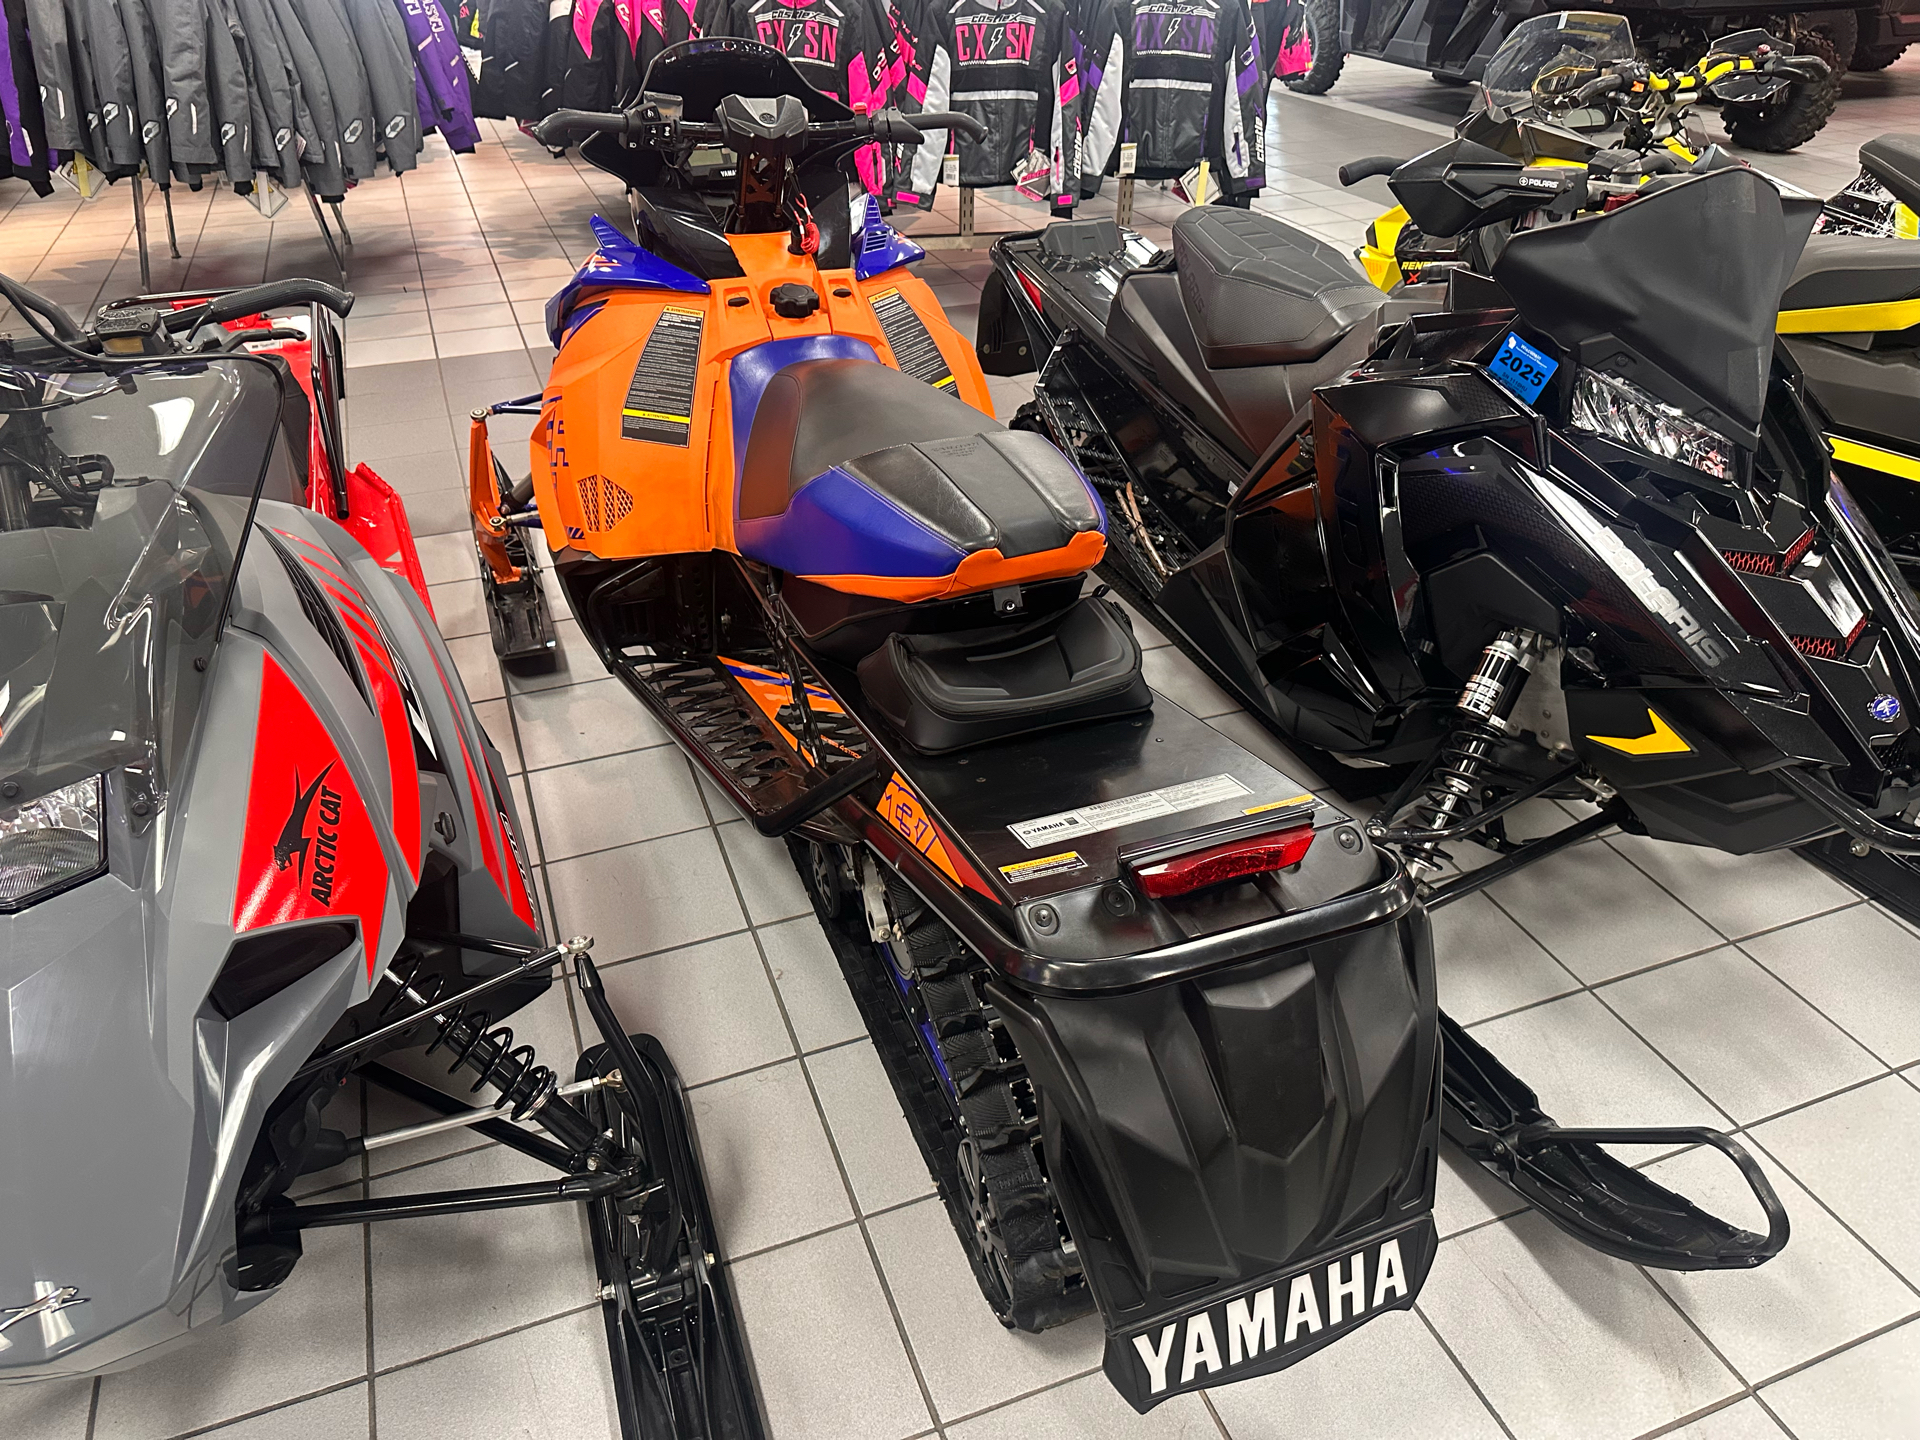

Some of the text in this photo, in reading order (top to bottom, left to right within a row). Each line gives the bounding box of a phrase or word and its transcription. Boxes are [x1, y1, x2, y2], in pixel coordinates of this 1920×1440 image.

[1528, 179, 1559, 188] POLARIS
[1178, 243, 1206, 314] POLARIS
[1499, 349, 1546, 387] 2025
[1594, 526, 1729, 669] POLARIS
[310, 784, 342, 908] ARCTIC CAT
[1030, 821, 1066, 834] YAMAHA
[1131, 1239, 1408, 1395] YAMAHA
